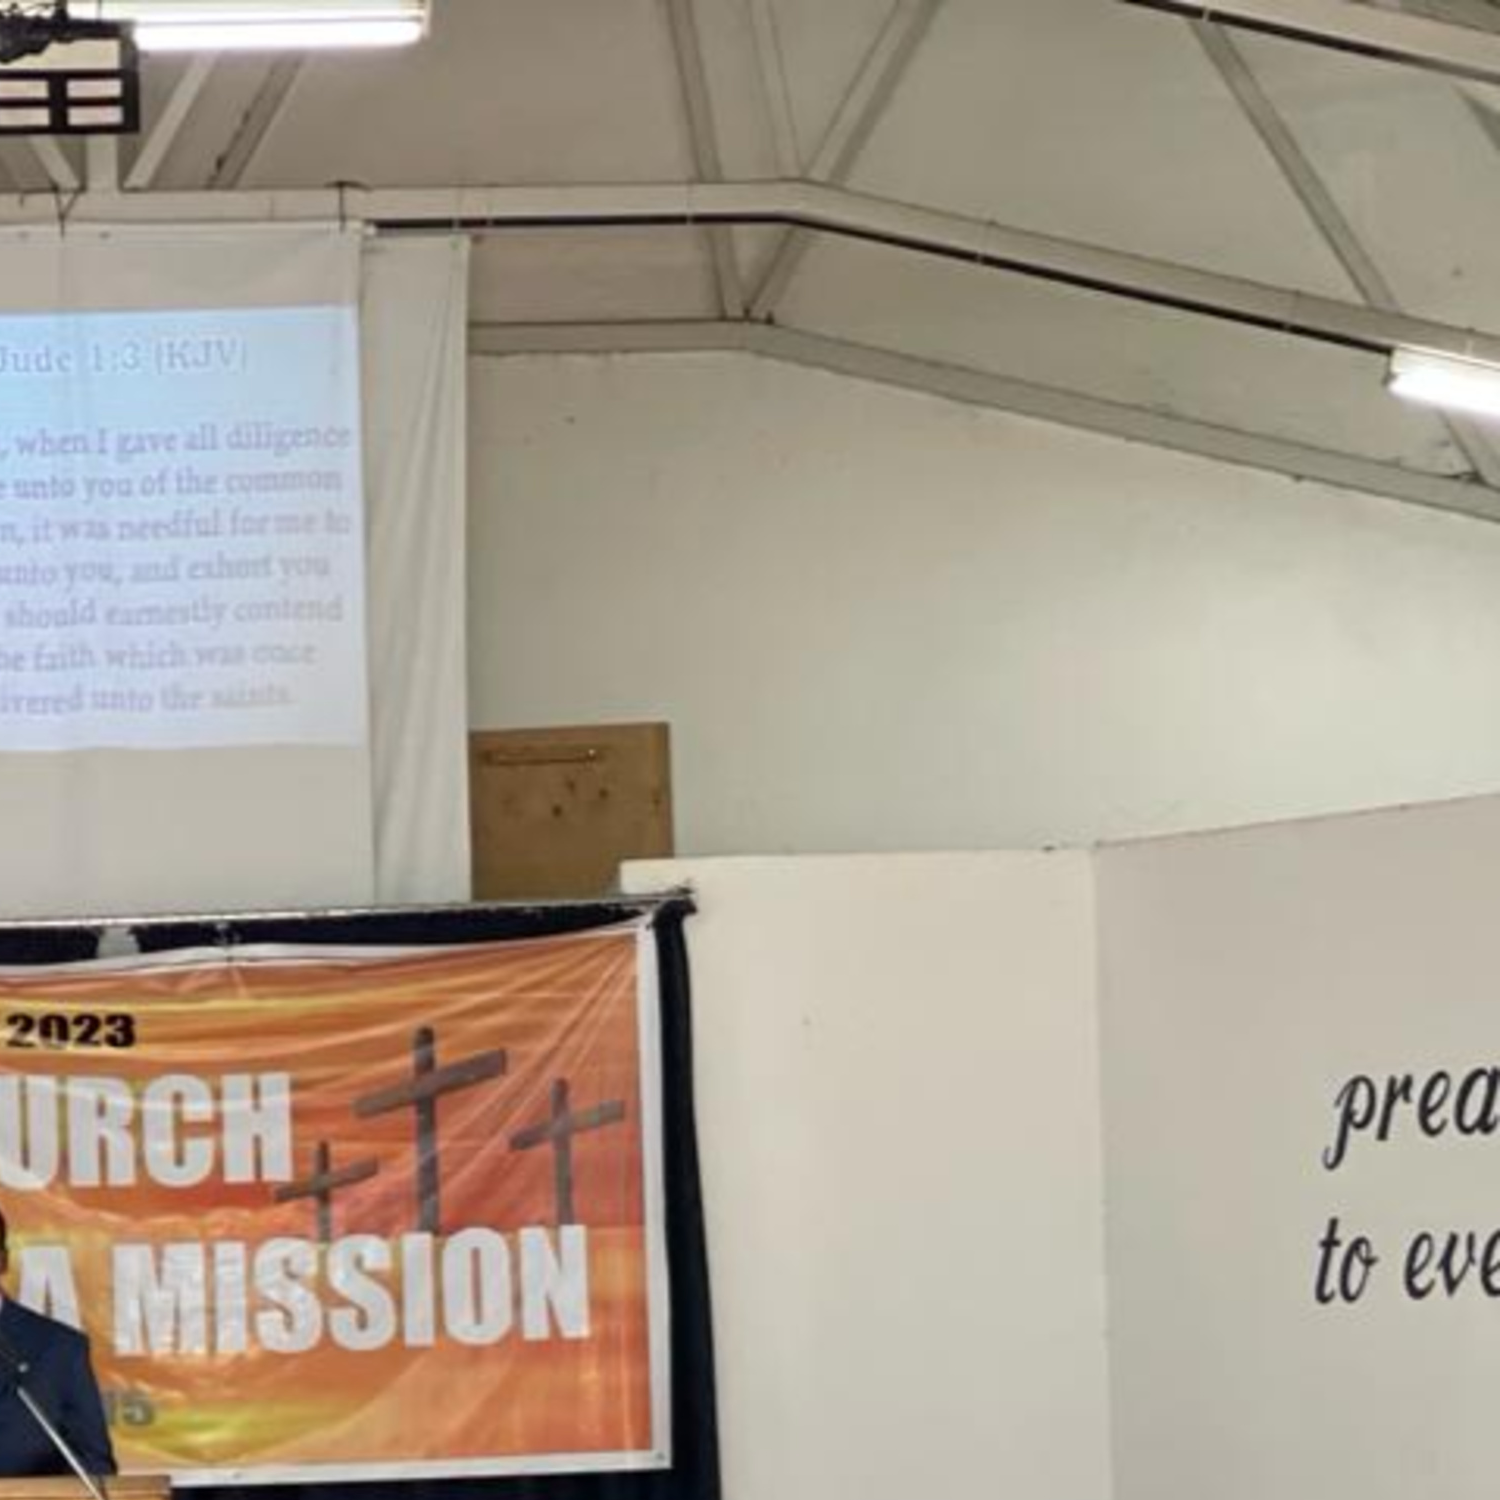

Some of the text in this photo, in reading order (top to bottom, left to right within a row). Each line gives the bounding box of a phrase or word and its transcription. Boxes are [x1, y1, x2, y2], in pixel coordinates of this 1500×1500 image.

[155, 336, 248, 376] (KJV)
[15, 427, 90, 456] when
[97, 427, 108, 454] I
[116, 430, 178, 463] gave
[183, 422, 218, 451] all
[14, 474, 75, 500] unto
[83, 475, 134, 505] you
[140, 467, 169, 496] of
[175, 465, 219, 494] the
[225, 471, 343, 494] common
[32, 515, 51, 543] it
[57, 520, 111, 541] was
[117, 507, 222, 541] needful
[229, 505, 271, 536] for
[273, 513, 317, 536] me
[325, 507, 350, 535] to
[129, 553, 180, 584] and
[277, 556, 330, 587] you
[5, 597, 96, 630] should
[34, 641, 96, 672] faith
[106, 639, 188, 671] which
[6, 1012, 137, 1049] 2023
[1314, 1216, 1379, 1305] to
[17, 1244, 84, 1337] A
[113, 1223, 591, 1358] MISSION
